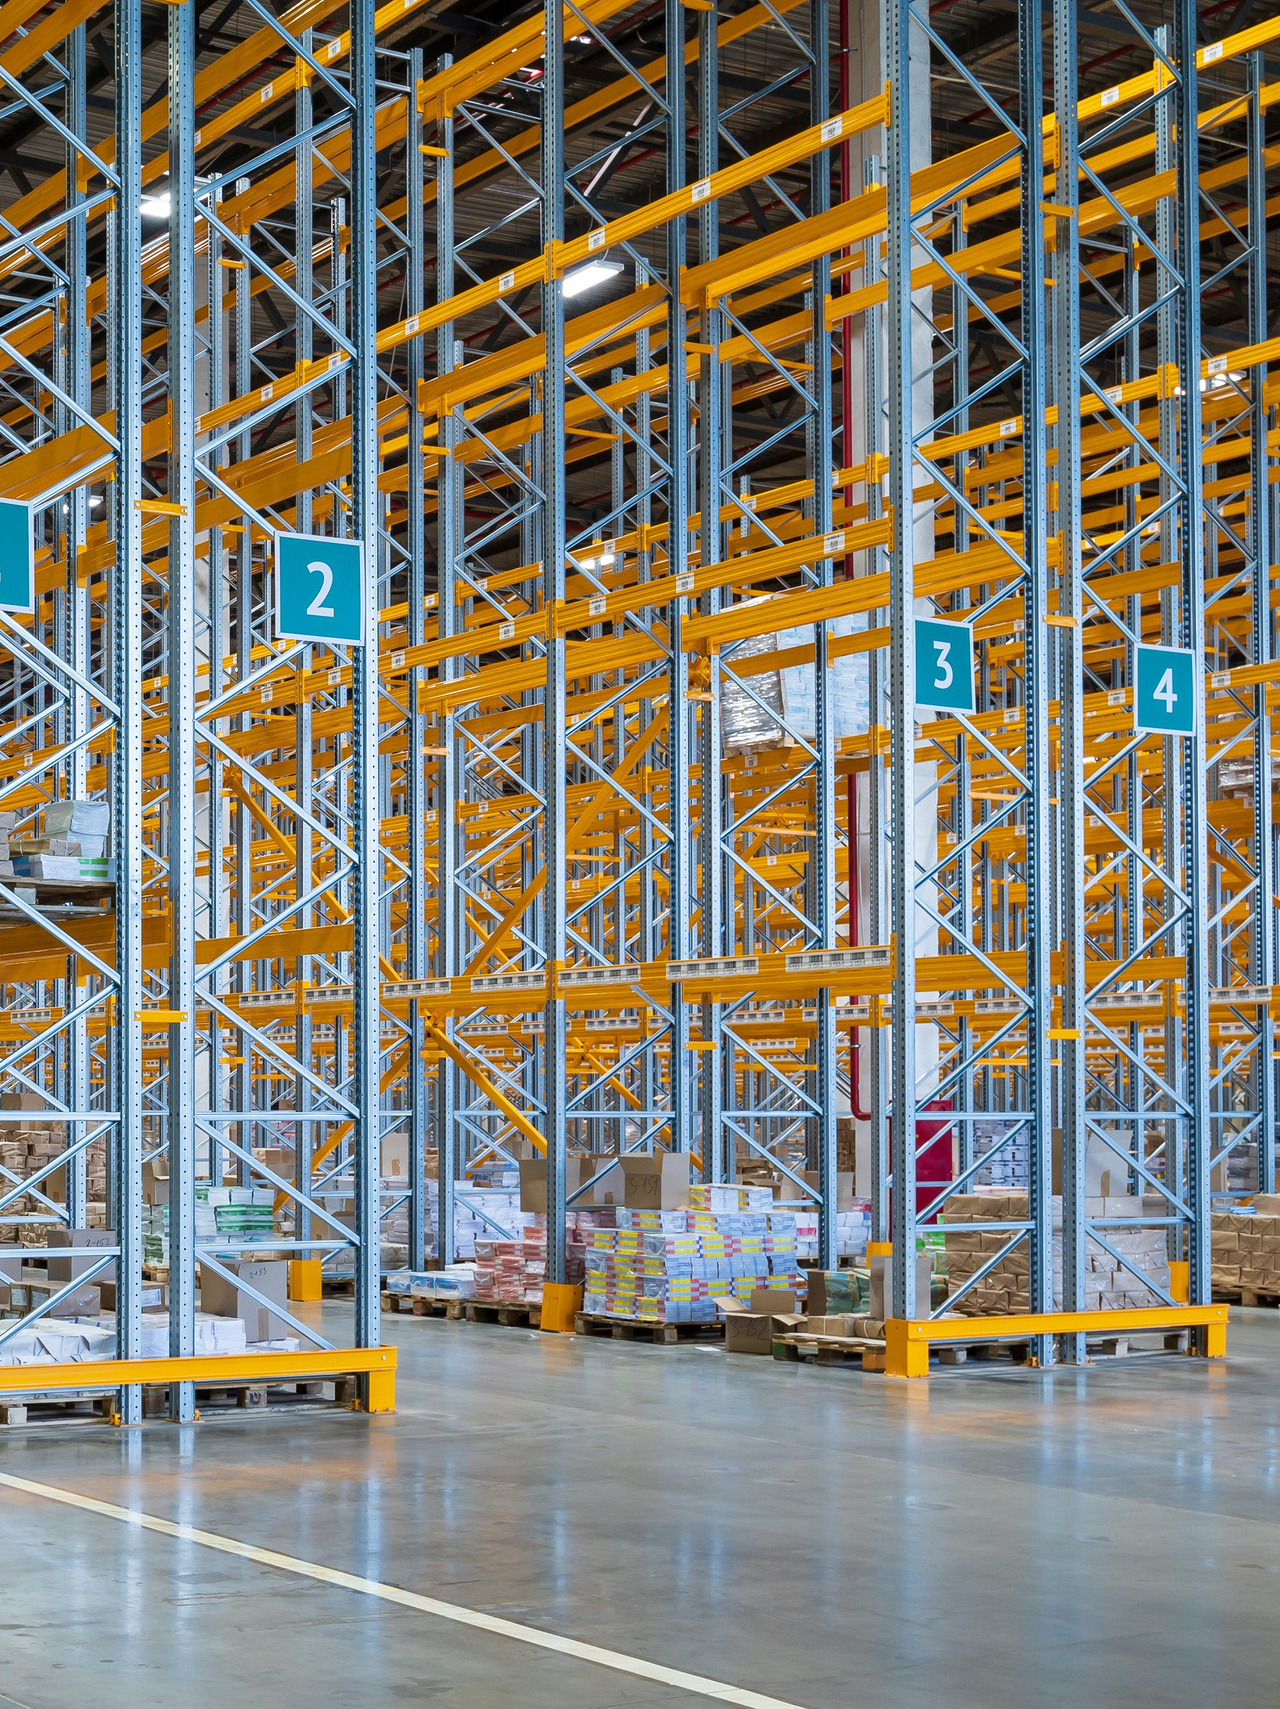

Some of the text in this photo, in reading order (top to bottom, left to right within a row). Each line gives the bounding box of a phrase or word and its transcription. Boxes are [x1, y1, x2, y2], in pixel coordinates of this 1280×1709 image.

[307, 562, 334, 617] 2
[934, 641, 952, 688] 3
[1154, 669, 1177, 712] 4
[627, 1175, 659, 1197] 3-151
[85, 1237, 112, 1247] 2-152
[249, 1267, 267, 1279] 2-153
[731, 1318, 771, 1341] 3-152
